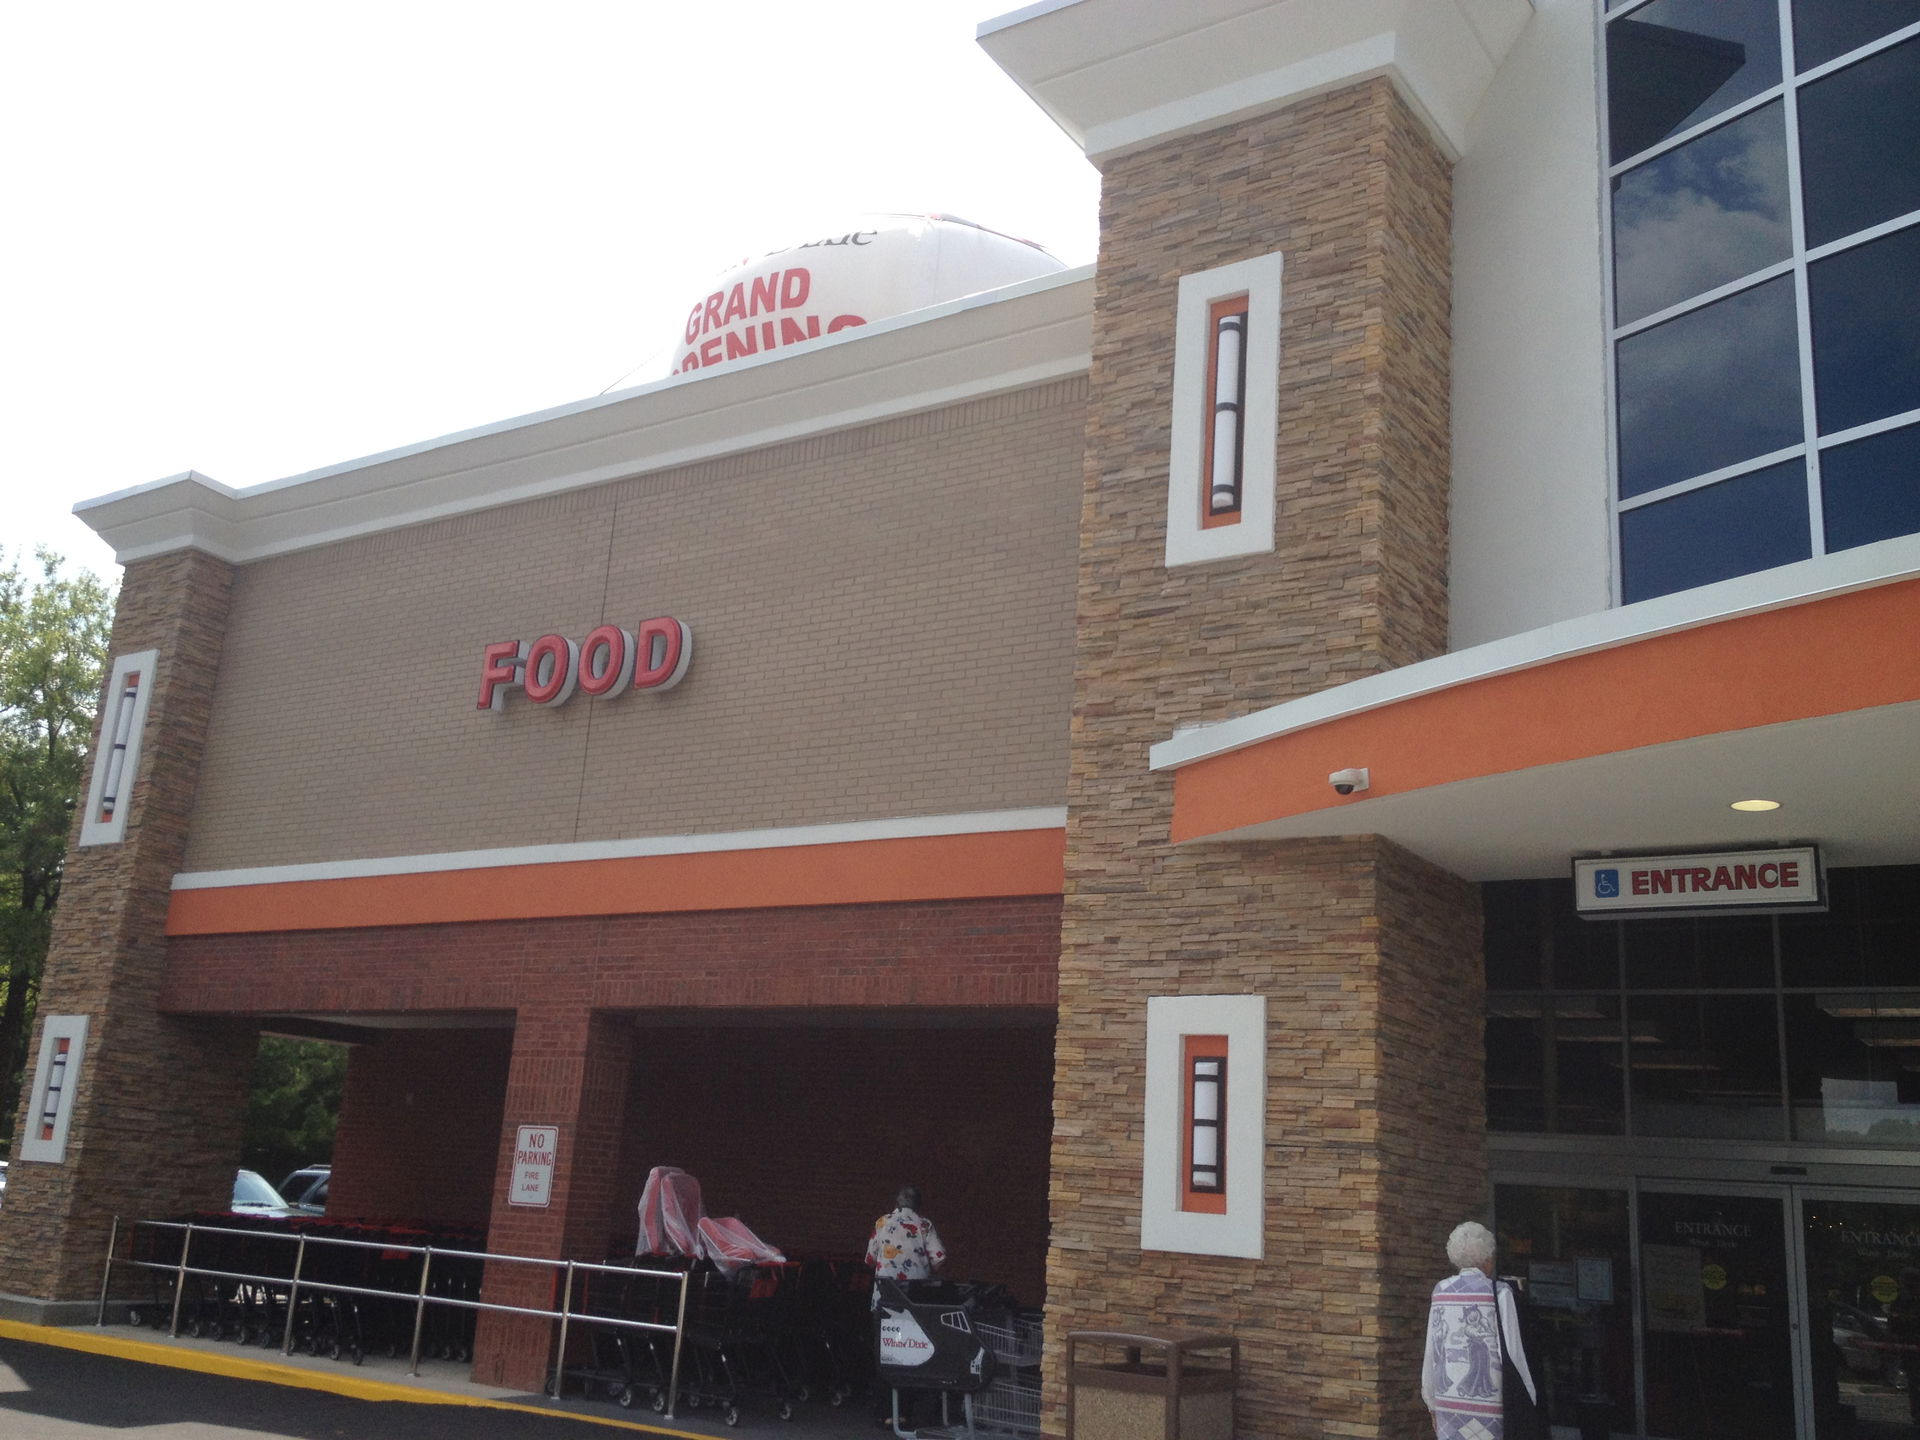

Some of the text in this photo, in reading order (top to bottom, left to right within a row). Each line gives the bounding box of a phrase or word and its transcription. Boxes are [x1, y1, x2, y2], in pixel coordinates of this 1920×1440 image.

[685, 267, 811, 345] GRAND
[477, 616, 688, 710] FOOD
[1631, 862, 1799, 895] ENTRANCE
[529, 1133, 544, 1148] NO
[517, 1150, 552, 1166] PARKING
[524, 1171, 540, 1180] FIRE
[521, 1183, 539, 1192] LANE
[1674, 1221, 1752, 1237] ENTRANCE
